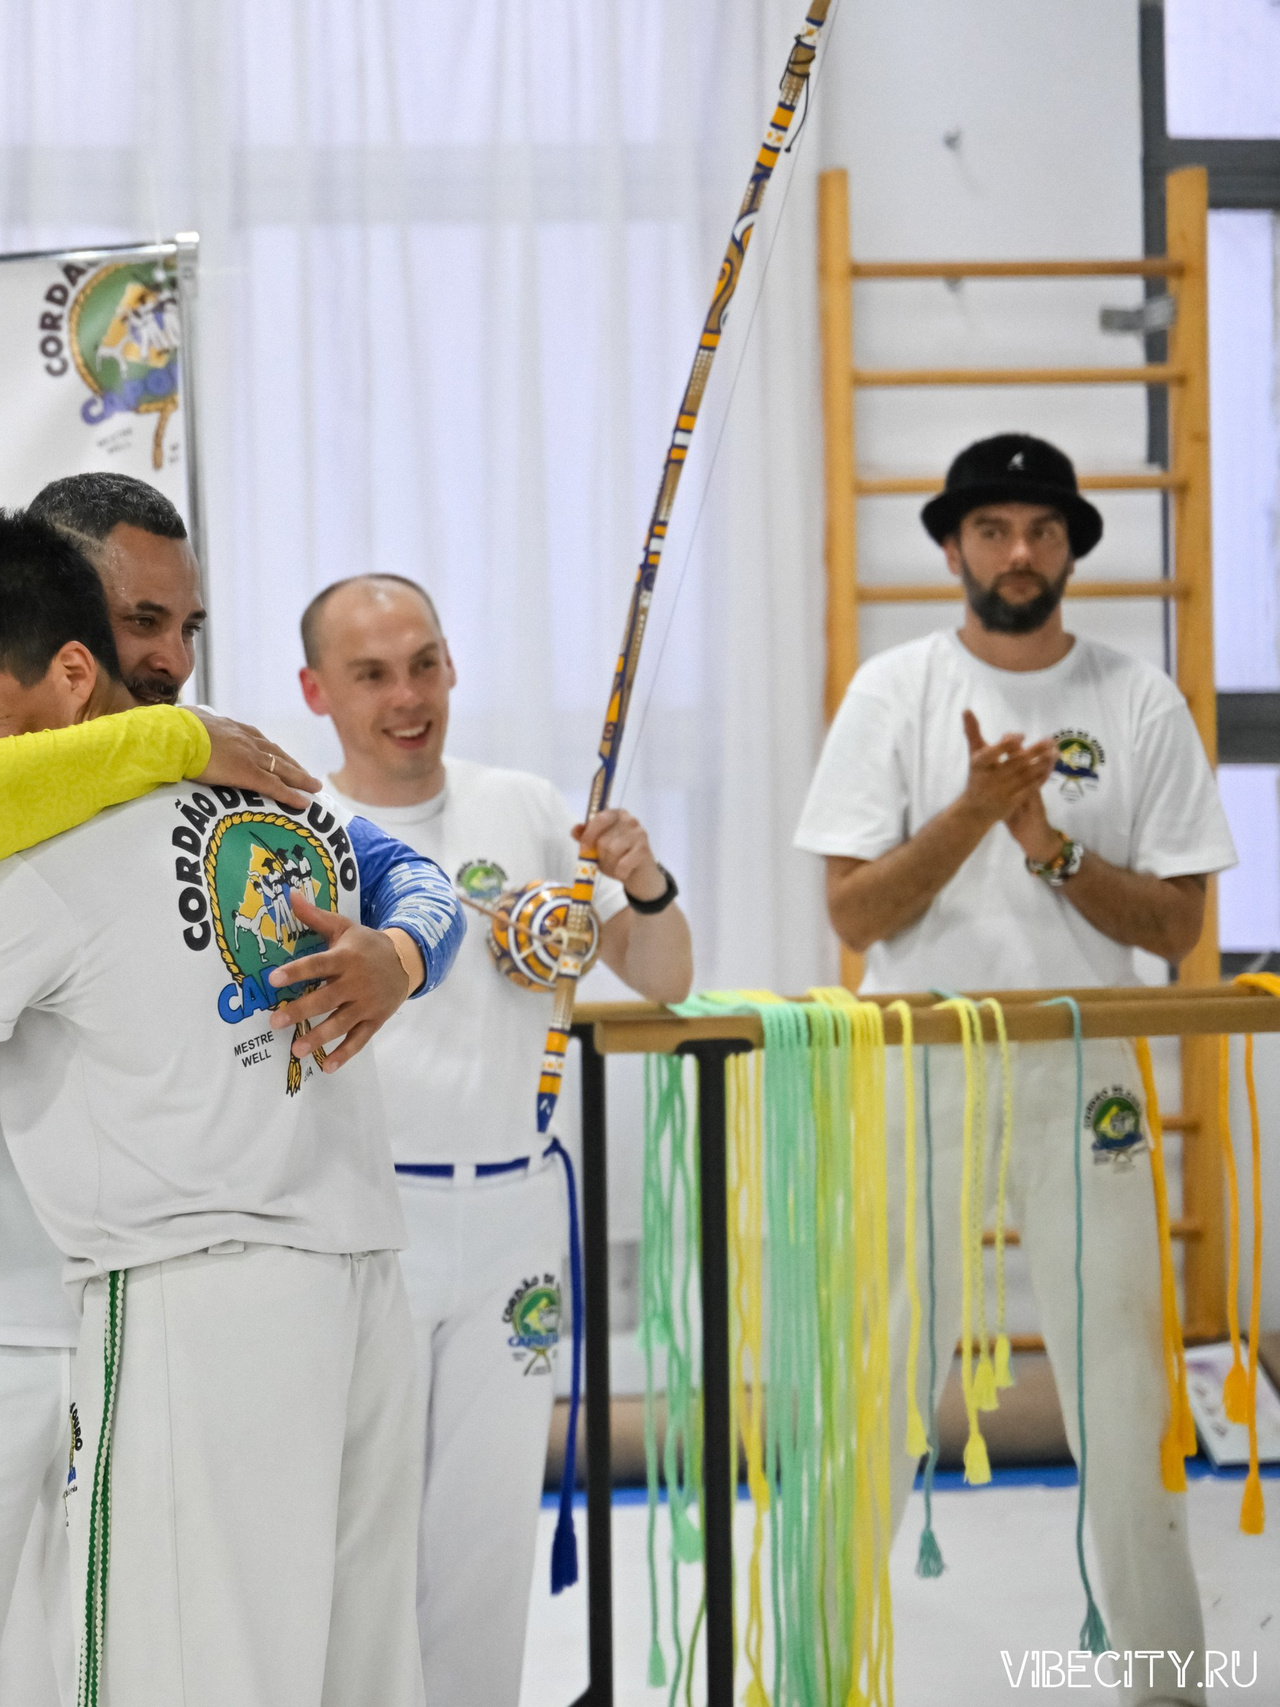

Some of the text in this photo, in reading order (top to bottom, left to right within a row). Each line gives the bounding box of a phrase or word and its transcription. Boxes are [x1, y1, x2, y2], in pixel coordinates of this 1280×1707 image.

[172, 791, 218, 952] CORDÃO
[234, 1031, 274, 1057] MESTRE
[242, 1049, 272, 1068] WELL
